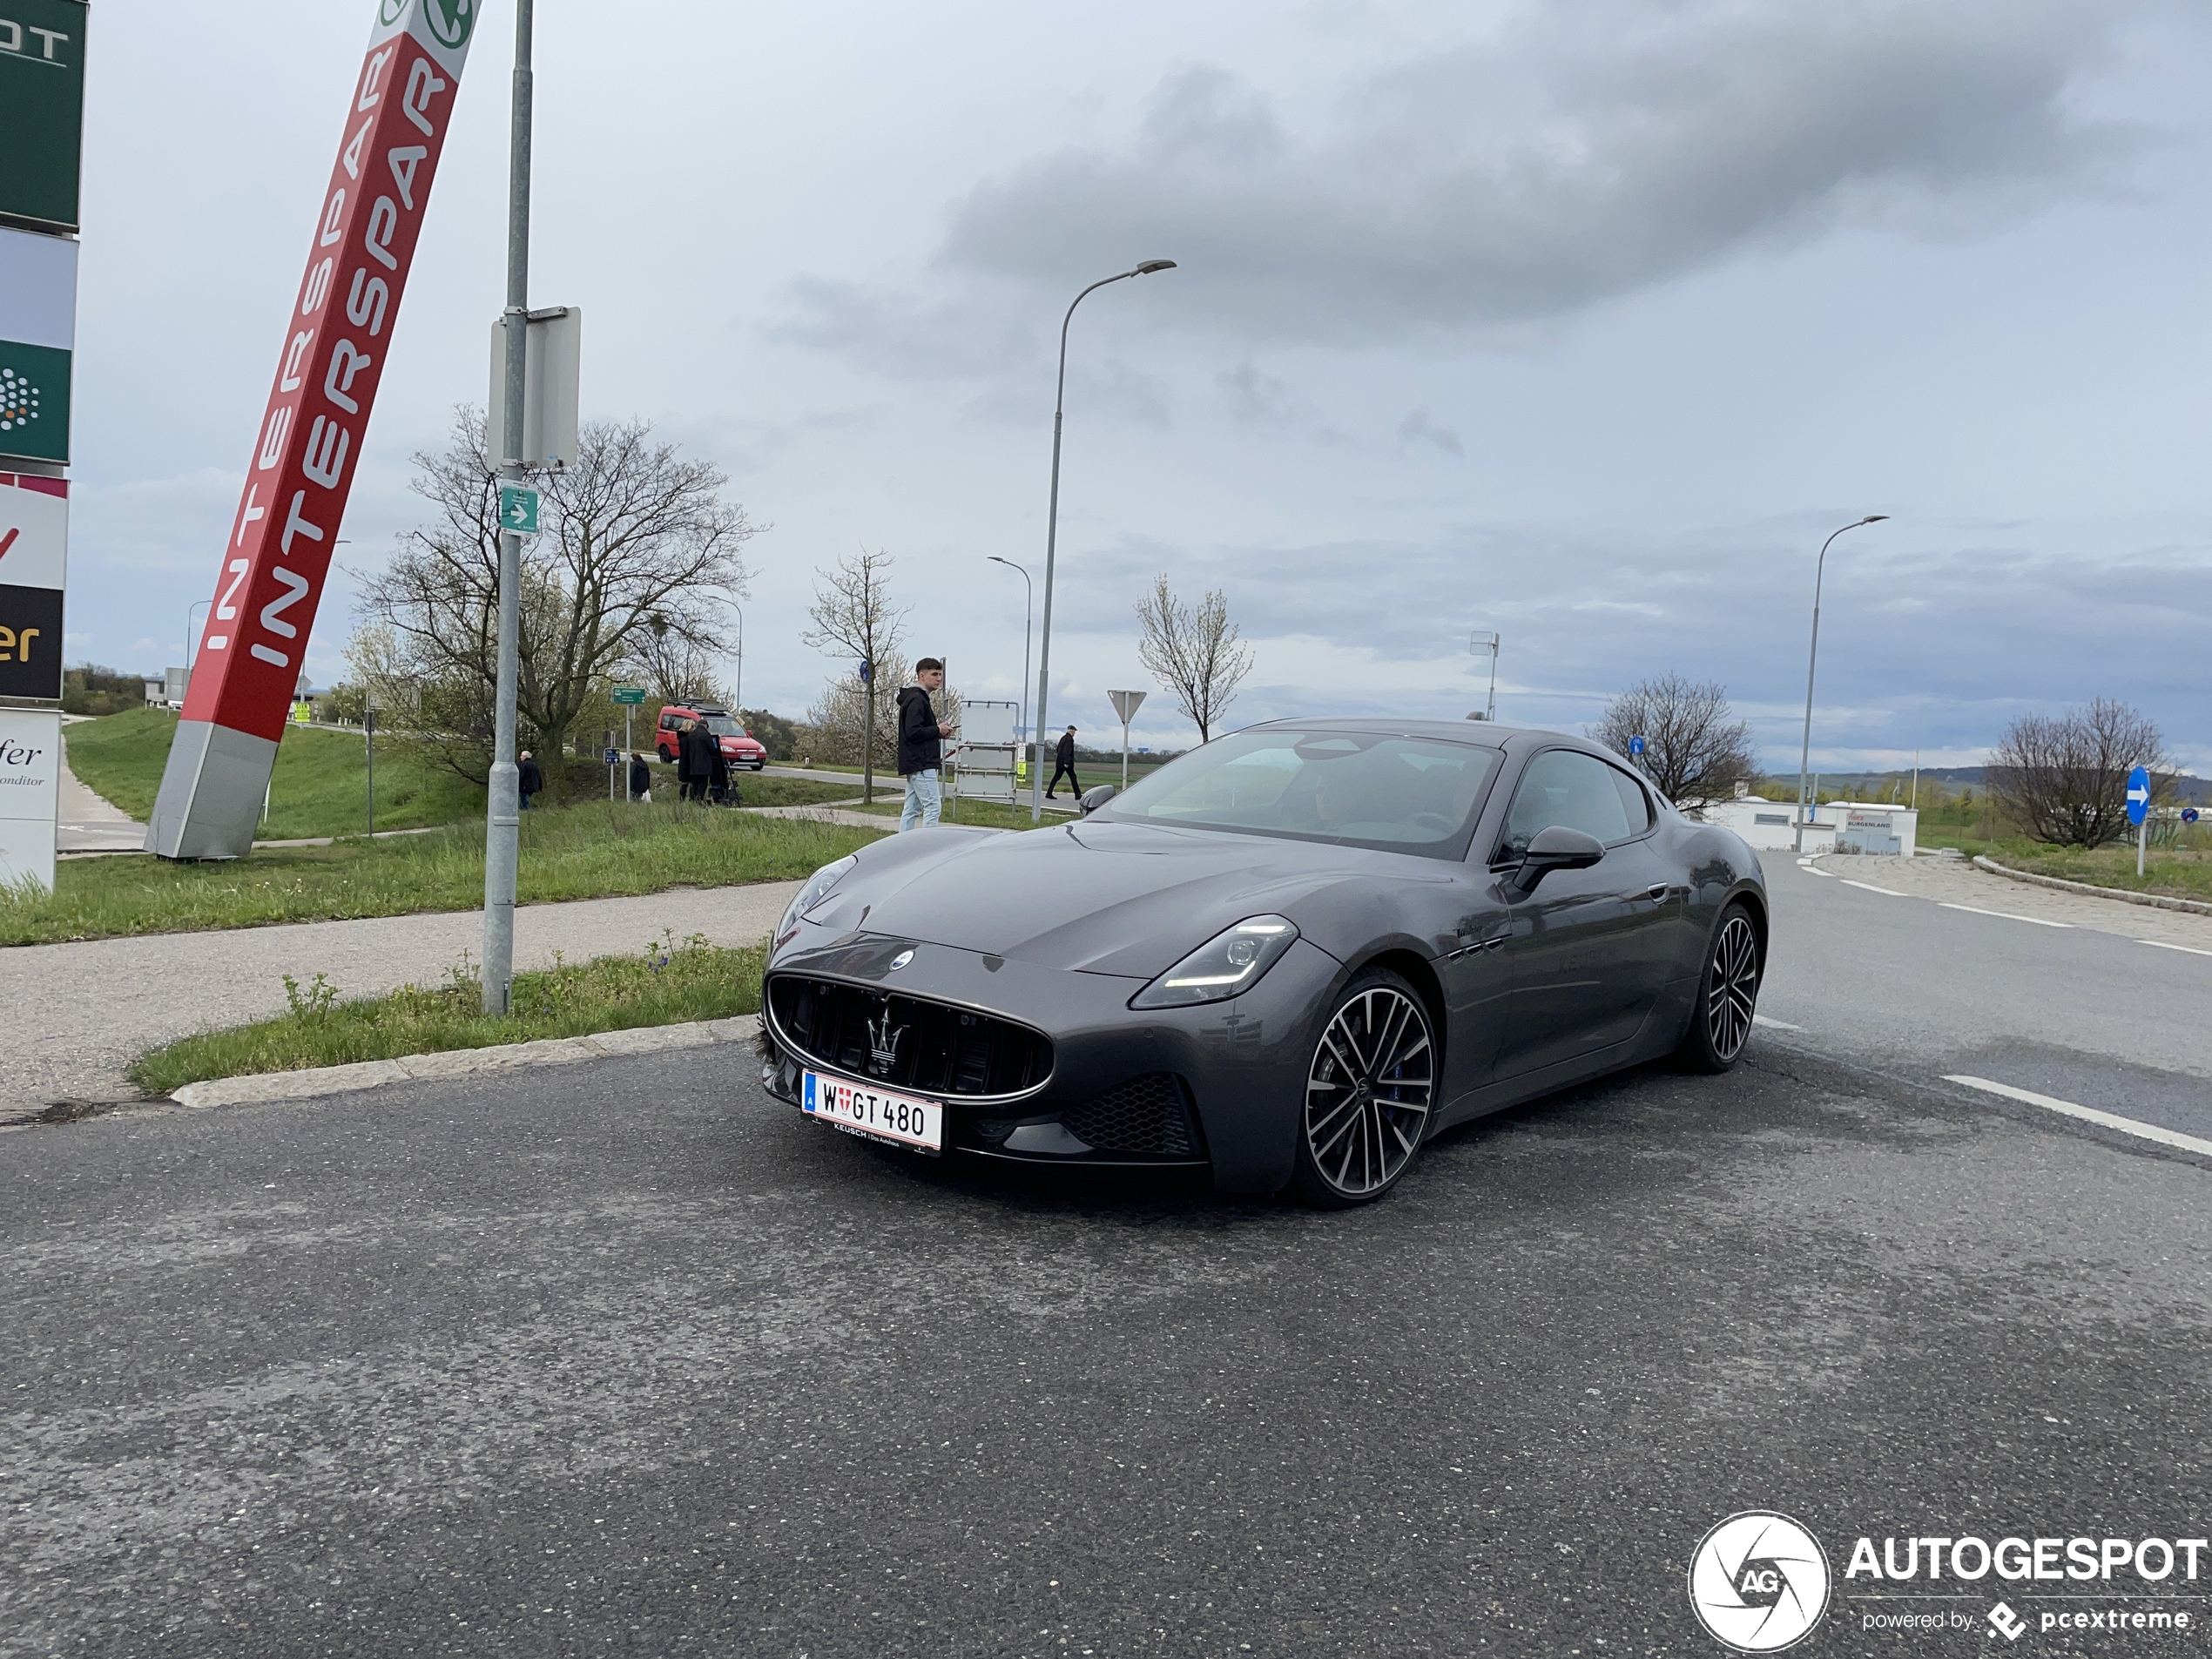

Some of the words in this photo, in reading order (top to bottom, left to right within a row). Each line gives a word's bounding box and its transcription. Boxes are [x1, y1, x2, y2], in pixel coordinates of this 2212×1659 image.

[207, 45, 393, 651] INTERSPAR
[250, 57, 446, 668] INTERSPAR
[806, 1096, 813, 1106] A
[823, 1082, 837, 1113] W
[853, 1092, 878, 1123] GT
[883, 1100, 924, 1136] 480
[833, 1123, 867, 1138] KEUSCH
[880, 1136, 900, 1148] Autohaus
